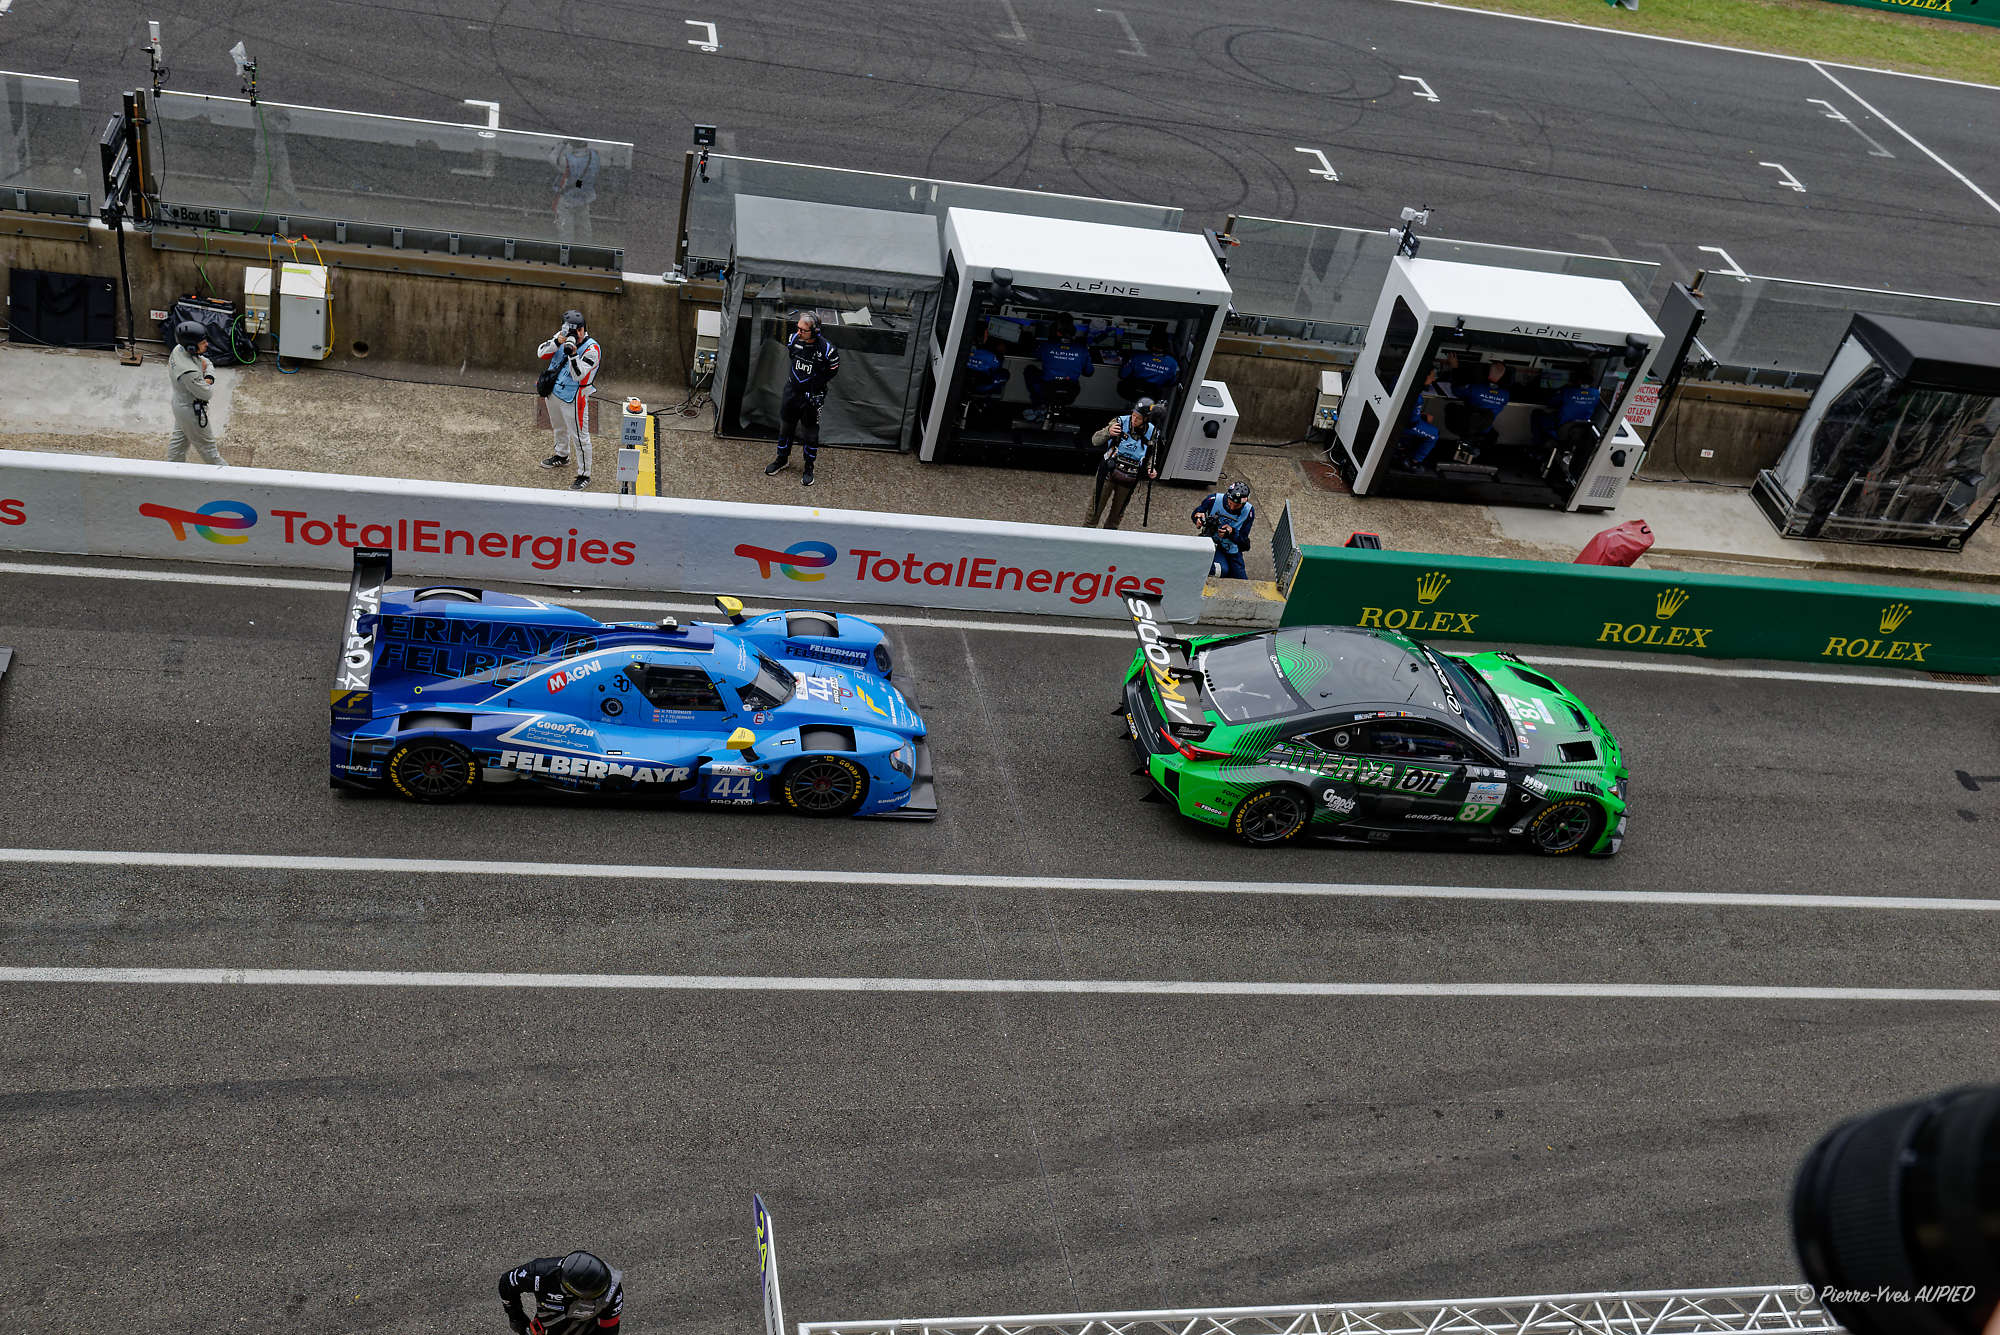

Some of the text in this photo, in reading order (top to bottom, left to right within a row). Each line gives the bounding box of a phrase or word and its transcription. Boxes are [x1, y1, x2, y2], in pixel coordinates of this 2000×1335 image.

[180, 208, 216, 223] Box 15
[1060, 281, 1142, 296] ALPINE
[1511, 326, 1584, 340] ALPINE
[271, 509, 636, 570] TotalEnergies
[849, 549, 1166, 604] TotalEnergies
[1357, 607, 1479, 635] ROLEX
[1597, 622, 1713, 648] ROLEX
[809, 644, 867, 659] FELBERMAYR
[1821, 637, 1932, 662] ROLEX
[547, 659, 602, 691] MAGNI
[613, 674, 629, 692] 30
[807, 676, 831, 701] 44
[1511, 697, 1540, 720] 87
[537, 721, 594, 737] GOODYEAR
[336, 764, 378, 772] GOODYEAR
[389, 748, 414, 797] GOODYEAR
[467, 762, 476, 784] EAGLE
[500, 750, 690, 782] FELBERMAYR
[840, 752, 862, 800] GOODYEAR
[712, 778, 751, 797] 44
[1402, 769, 1441, 793] OIL
[1236, 791, 1271, 827] GOODYEAR
[1404, 813, 1455, 822] GOODYEAR
[1459, 804, 1497, 822] 87
